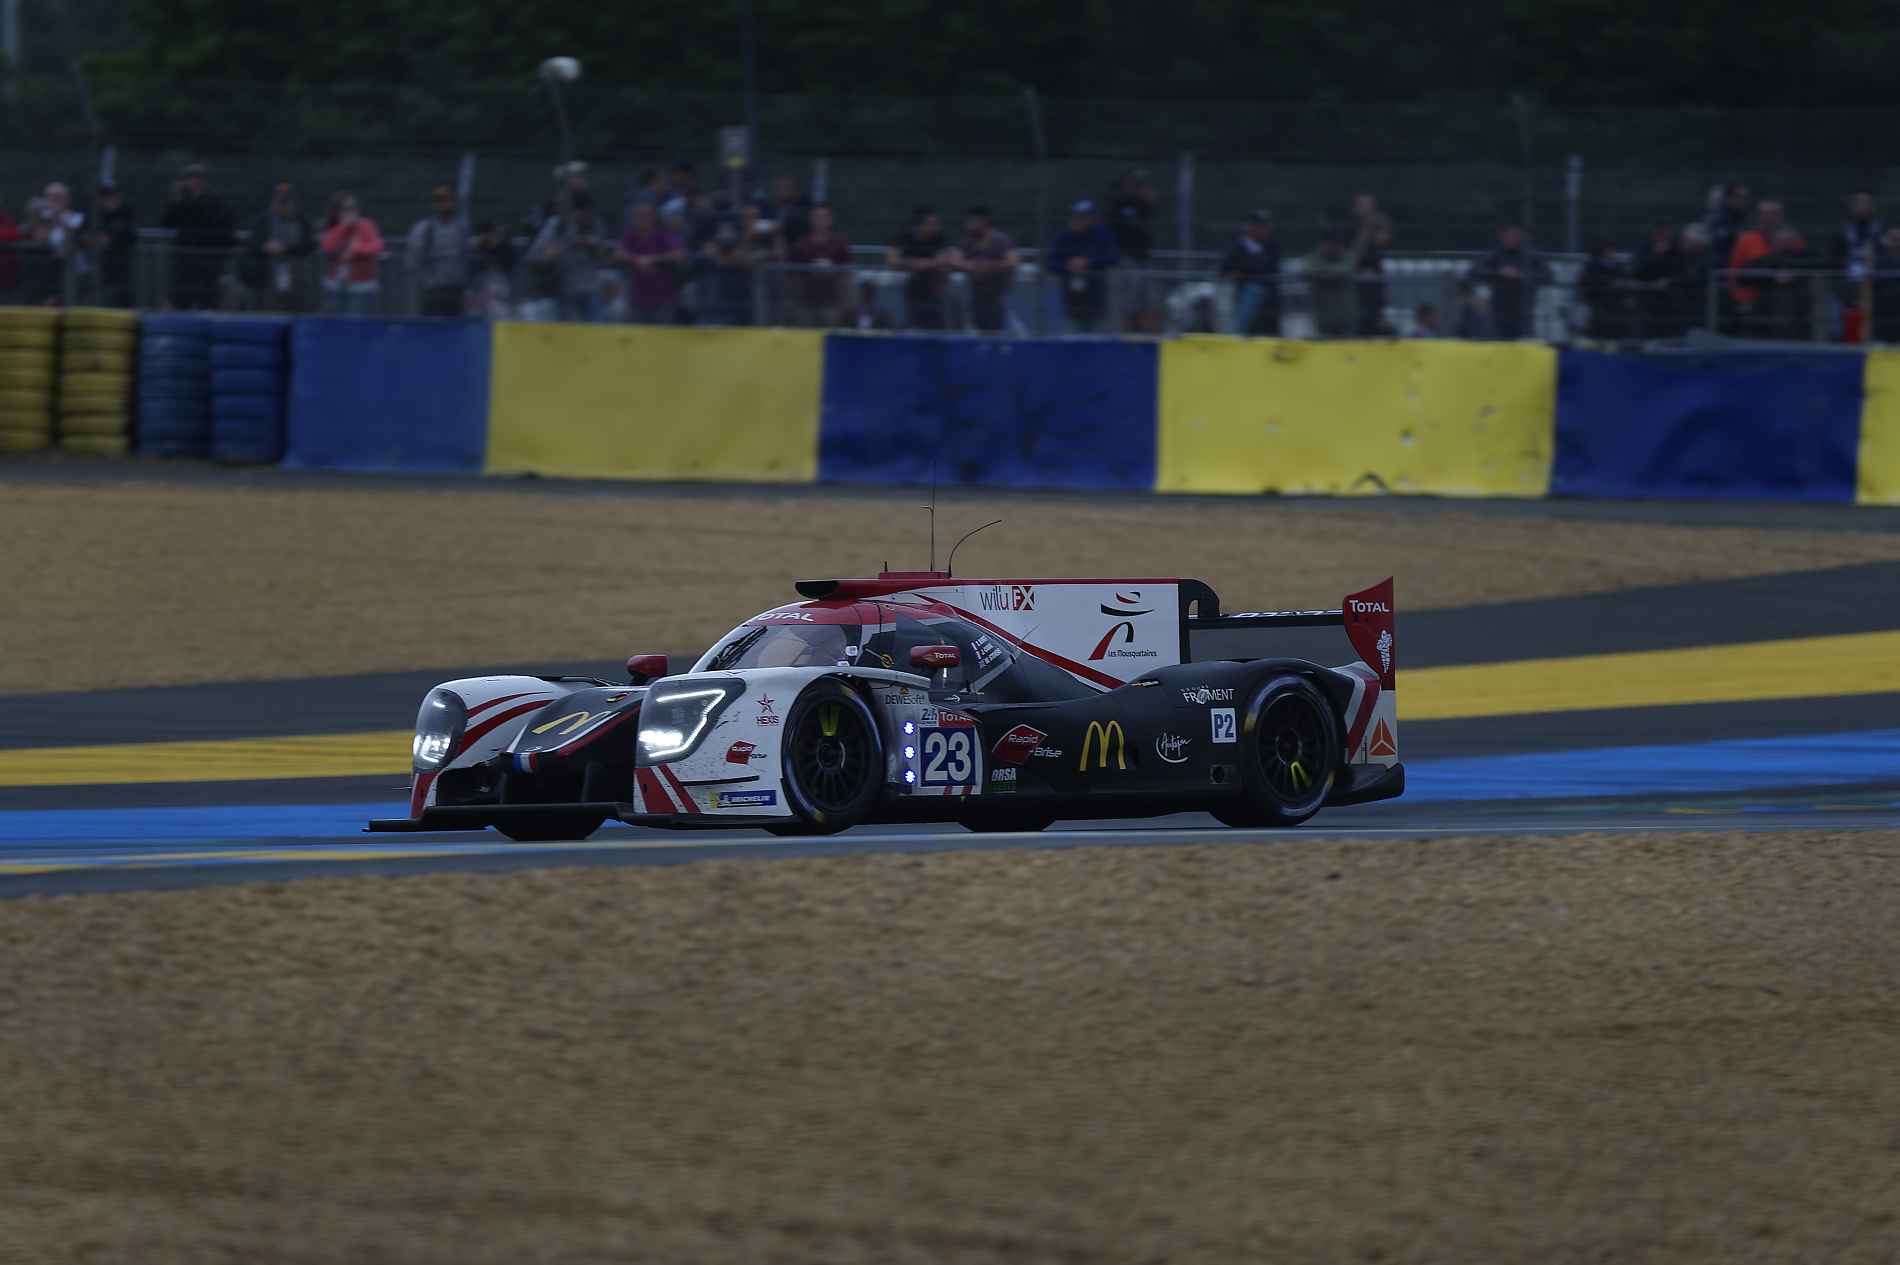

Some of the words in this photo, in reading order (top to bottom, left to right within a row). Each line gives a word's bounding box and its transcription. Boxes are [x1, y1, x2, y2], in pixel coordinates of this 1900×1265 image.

[1349, 600, 1390, 613] TOTAL
[1214, 714, 1234, 738] P2
[925, 732, 971, 781] 23
